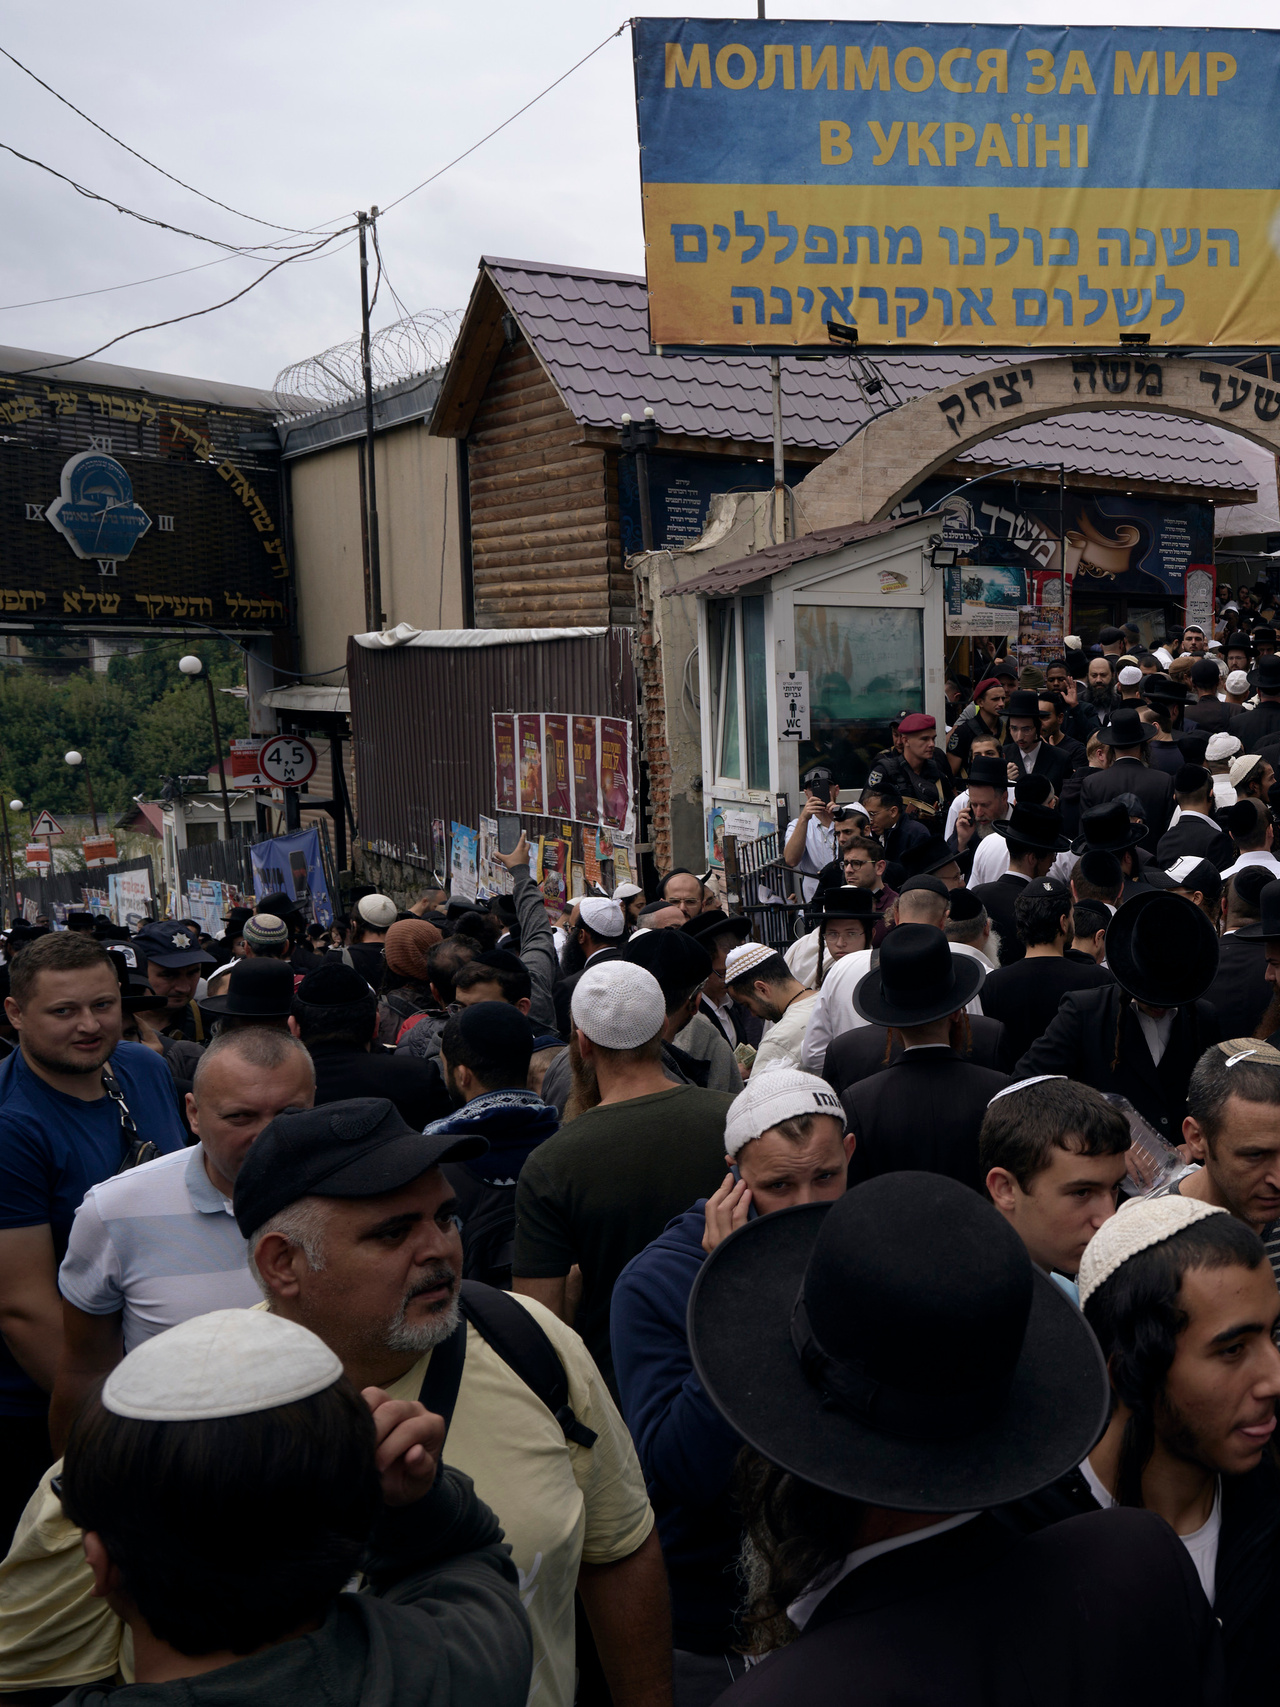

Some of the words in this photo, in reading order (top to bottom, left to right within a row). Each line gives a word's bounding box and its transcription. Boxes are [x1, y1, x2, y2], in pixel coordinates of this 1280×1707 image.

[665, 43, 1008, 94] МОЛИМОСЯ
[1026, 49, 1097, 95] ЗА
[1113, 50, 1238, 96] МИР
[820, 120, 853, 166] В
[867, 112, 1089, 168] УКРАЇНІ
[670, 210, 923, 265] מתפללים
[939, 213, 1079, 266] כולנו
[1097, 226, 1241, 268] השנה
[730, 286, 996, 338] אוקראינה
[1012, 274, 1186, 327] לשלום
[1072, 360, 1163, 396] משה
[43, 385, 78, 415] על
[938, 367, 1035, 438] יצחק
[88, 435, 112, 453] XII
[25, 503, 45, 521] IX
[158, 515, 174, 531] III
[980, 500, 1057, 567] משרד
[97, 560, 117, 576] VI
[63, 585, 120, 614] שלא
[135, 594, 213, 620] והעיקר
[224, 590, 284, 618] והכלל
[786, 719, 801, 728] WC
[267, 747, 304, 767] 4,5
[252, 775, 261, 784] 4
[283, 768, 295, 777] М
